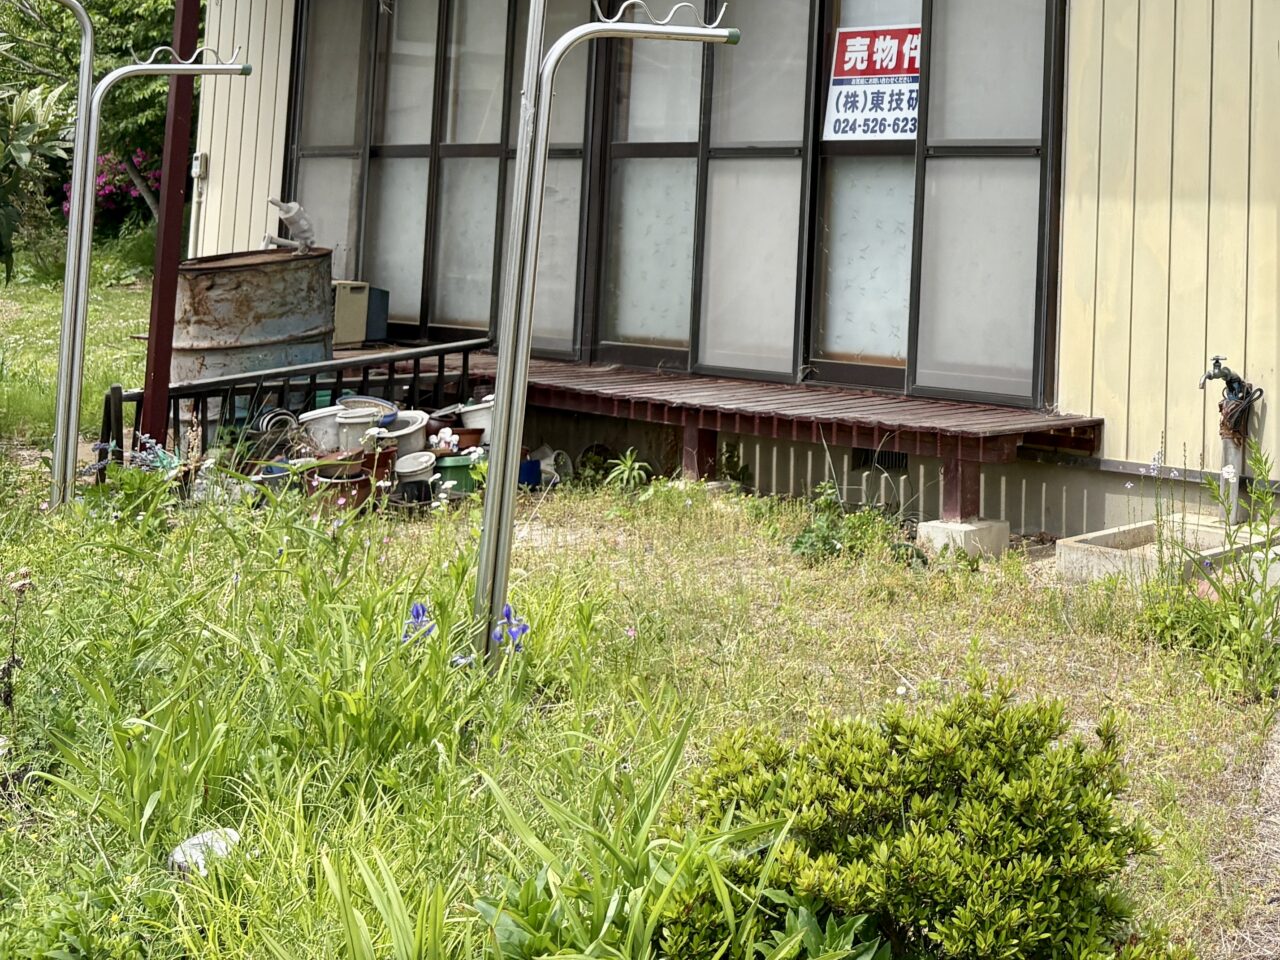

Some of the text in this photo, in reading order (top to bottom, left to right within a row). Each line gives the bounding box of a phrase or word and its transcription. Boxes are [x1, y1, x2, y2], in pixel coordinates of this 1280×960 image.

[843, 33, 921, 72] 売物件
[833, 117, 917, 134] 024-526-623
